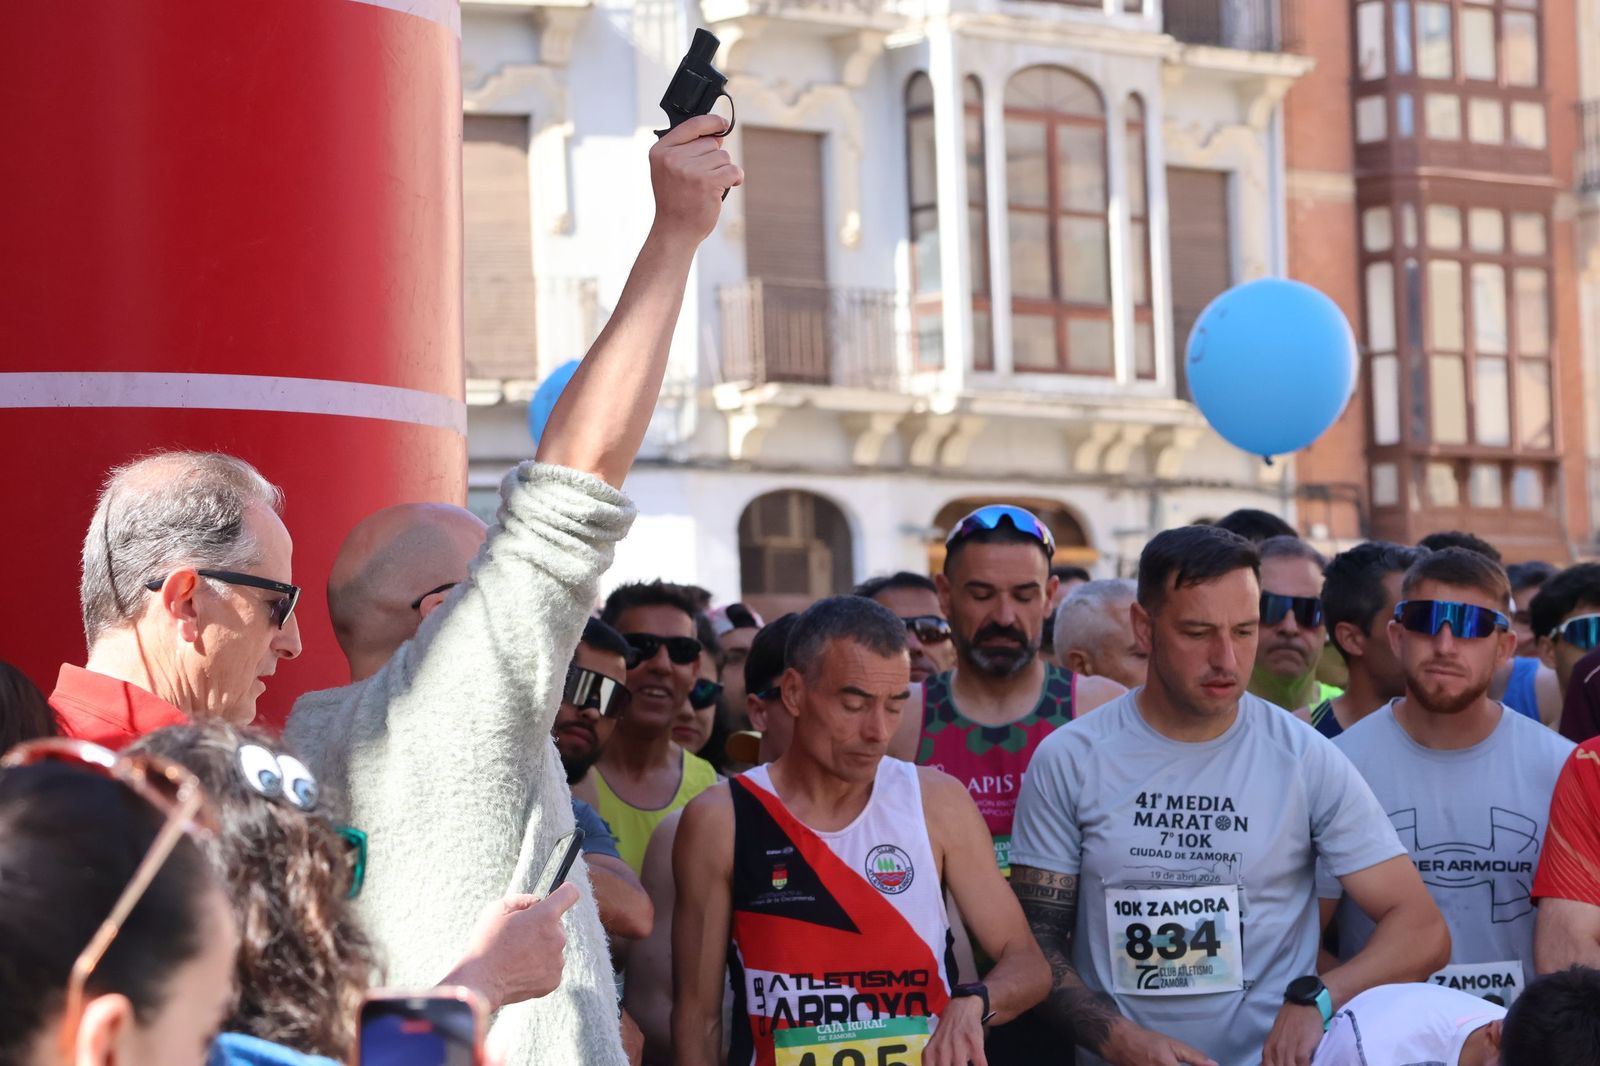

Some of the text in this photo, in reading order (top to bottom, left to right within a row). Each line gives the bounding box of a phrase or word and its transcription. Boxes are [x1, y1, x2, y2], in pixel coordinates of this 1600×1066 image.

[967, 774, 1014, 794] APIS
[1166, 795, 1235, 812] MEDIA
[1177, 833, 1212, 848] 10K
[1129, 847, 1238, 863] CIUDAD DE ZAMORA
[1447, 860, 1533, 873] ARMOUR
[1151, 871, 1221, 883] 19 de abril 2026
[1114, 897, 1230, 916] 10K ZAMORA
[1125, 920, 1221, 961] 834
[1159, 964, 1213, 977] CLUB ATLETISMO
[769, 969, 929, 993] ATLETISMO
[1160, 977, 1189, 988] ZAMORA
[816, 1018, 887, 1034] CAJA RURAL
[829, 1032, 857, 1041] ZAMORA
